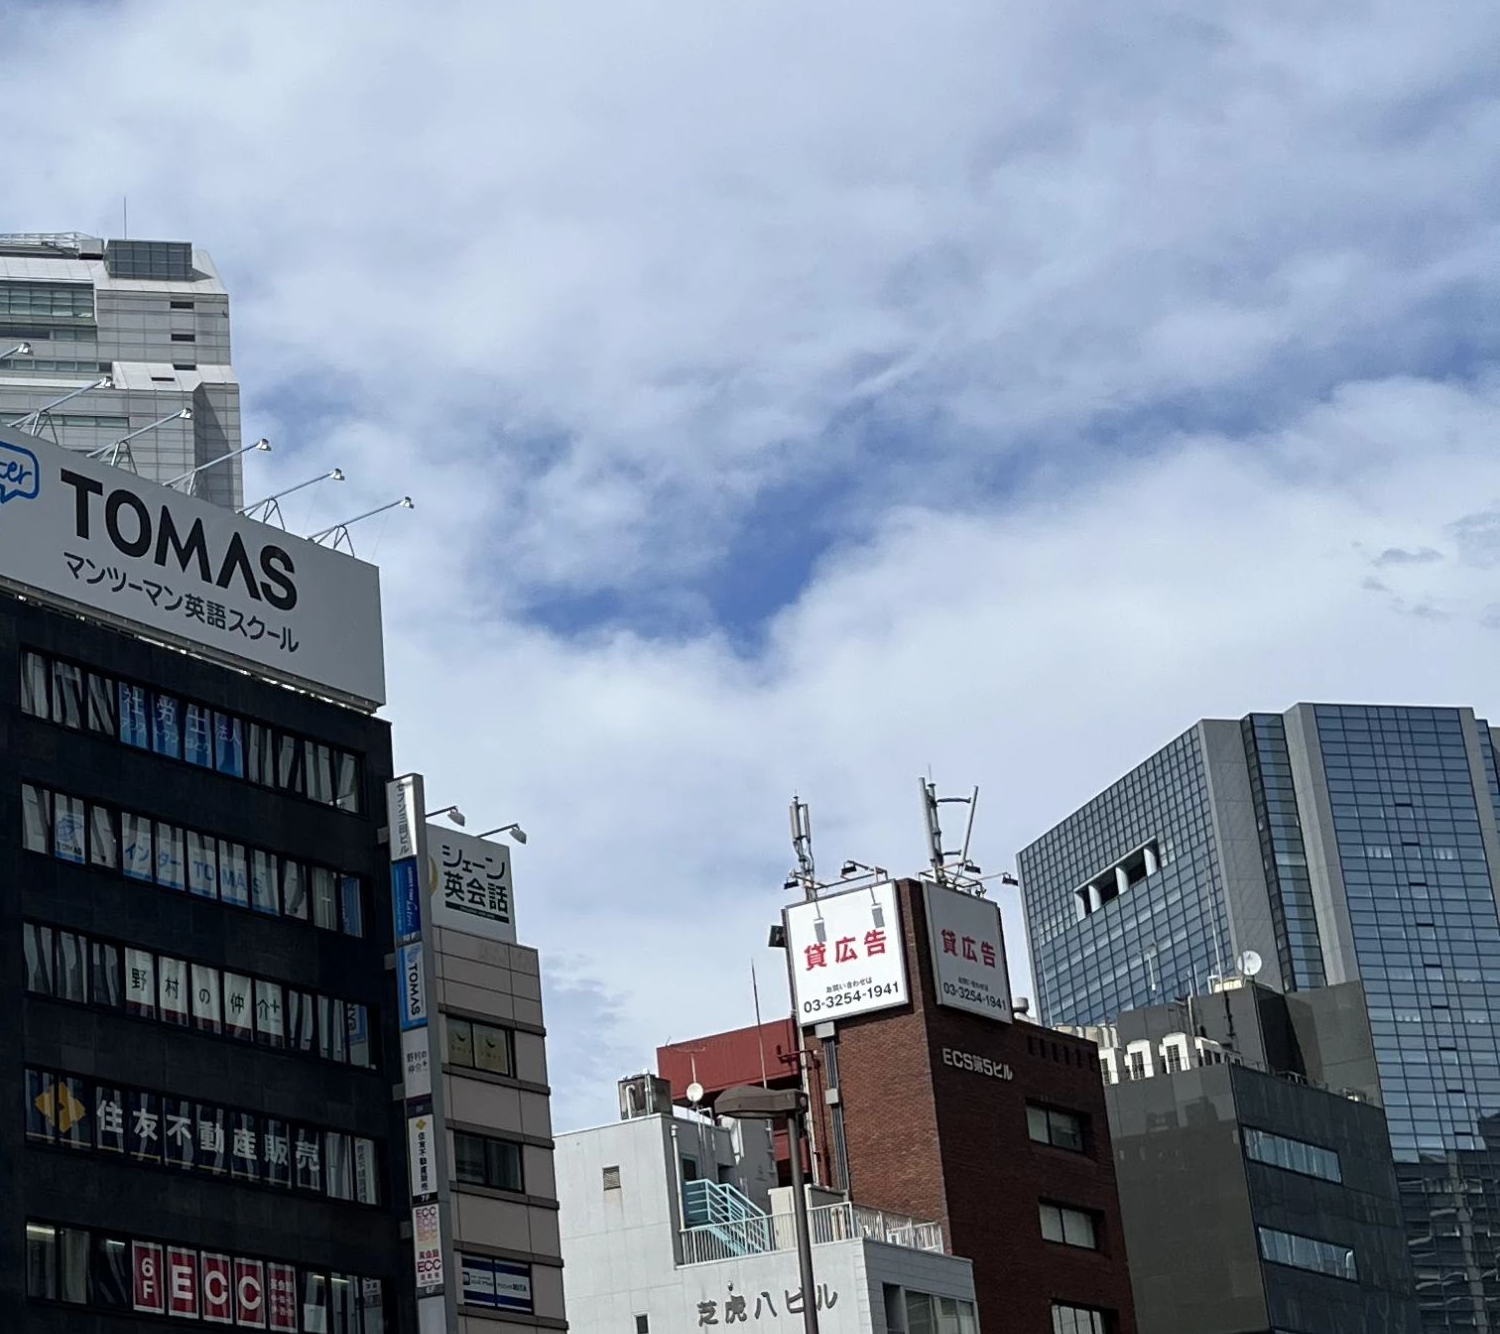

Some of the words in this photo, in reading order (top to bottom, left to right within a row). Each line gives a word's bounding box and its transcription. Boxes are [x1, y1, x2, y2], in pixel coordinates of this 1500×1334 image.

[61, 468, 297, 611] TOMAS
[63, 552, 299, 653] マンツーマン英語スクール
[442, 844, 506, 880] シェーン
[444, 871, 509, 914] 英会話
[803, 929, 887, 971] 貸広告
[941, 928, 997, 969] 貸広告
[408, 964, 422, 1016] TOMAS
[803, 981, 900, 1014] 03-3254-1941
[825, 976, 873, 994] お問い合わせは
[943, 981, 1007, 1012] 03-3254-1941
[942, 1047, 1014, 1082] ECS第5ビル
[96, 1099, 321, 1173] 住友不動産販売
[171, 1264, 262, 1310] ECC
[417, 1259, 441, 1273] ECC
[696, 1283, 838, 1327] 芝虎八ビル
